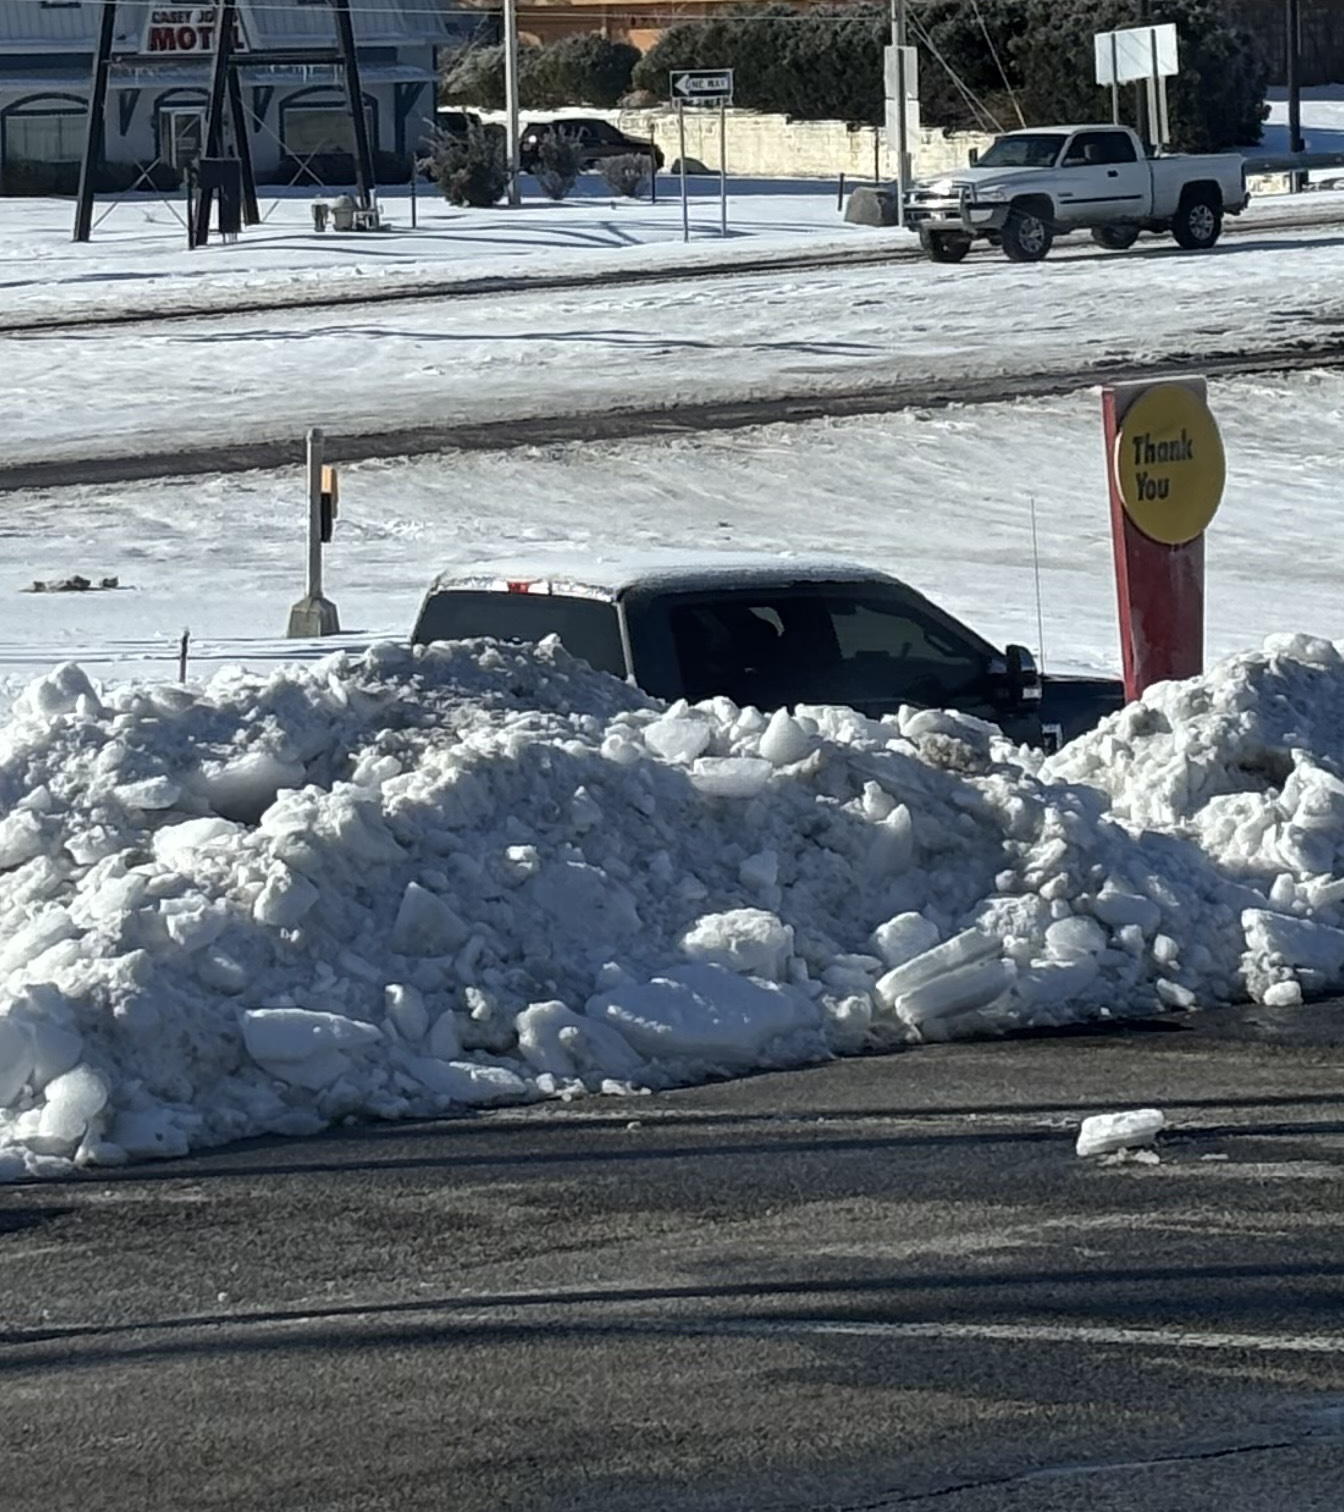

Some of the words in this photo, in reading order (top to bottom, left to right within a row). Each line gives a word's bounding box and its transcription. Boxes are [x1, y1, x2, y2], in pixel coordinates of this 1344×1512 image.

[148, 26, 245, 51] MOTL
[1132, 428, 1194, 466] Thank
[1135, 471, 1170, 502] You
